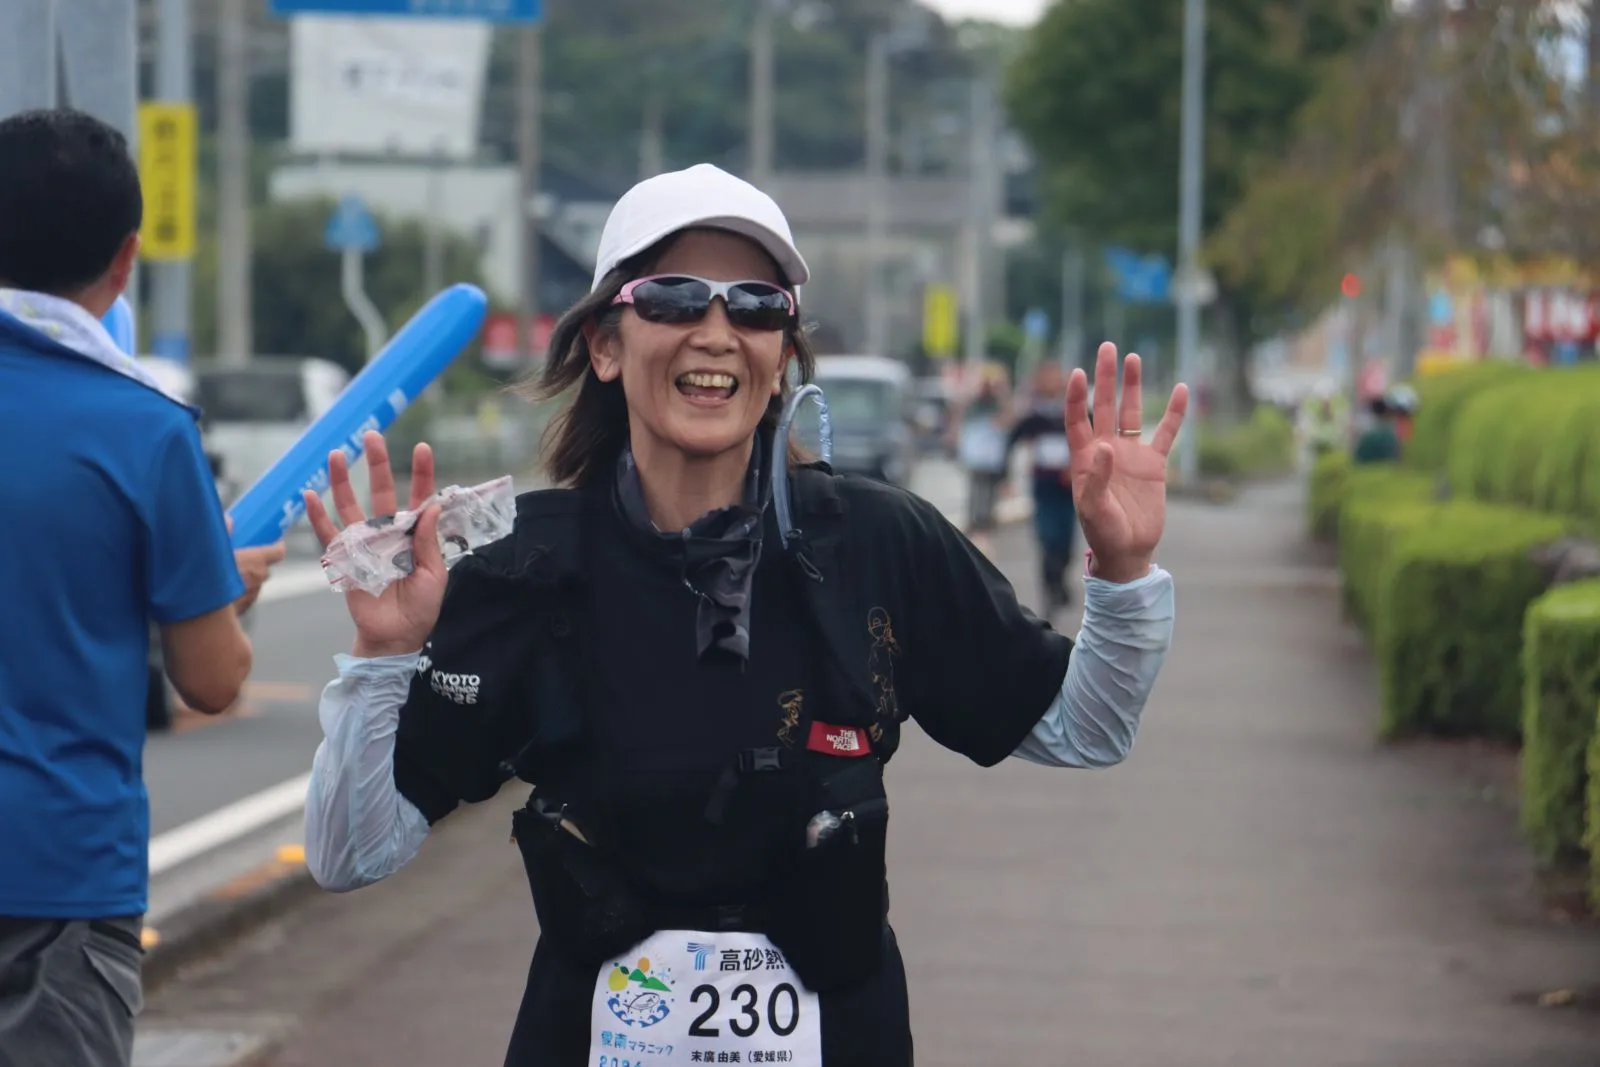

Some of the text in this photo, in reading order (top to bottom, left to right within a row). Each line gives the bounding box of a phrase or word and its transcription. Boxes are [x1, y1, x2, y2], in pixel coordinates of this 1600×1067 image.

[431, 669, 480, 687] KYOTO
[826, 734, 851, 744] NORTH
[832, 741, 852, 750] FACE
[720, 947, 785, 971] 高砂熱
[688, 982, 799, 1037] 230
